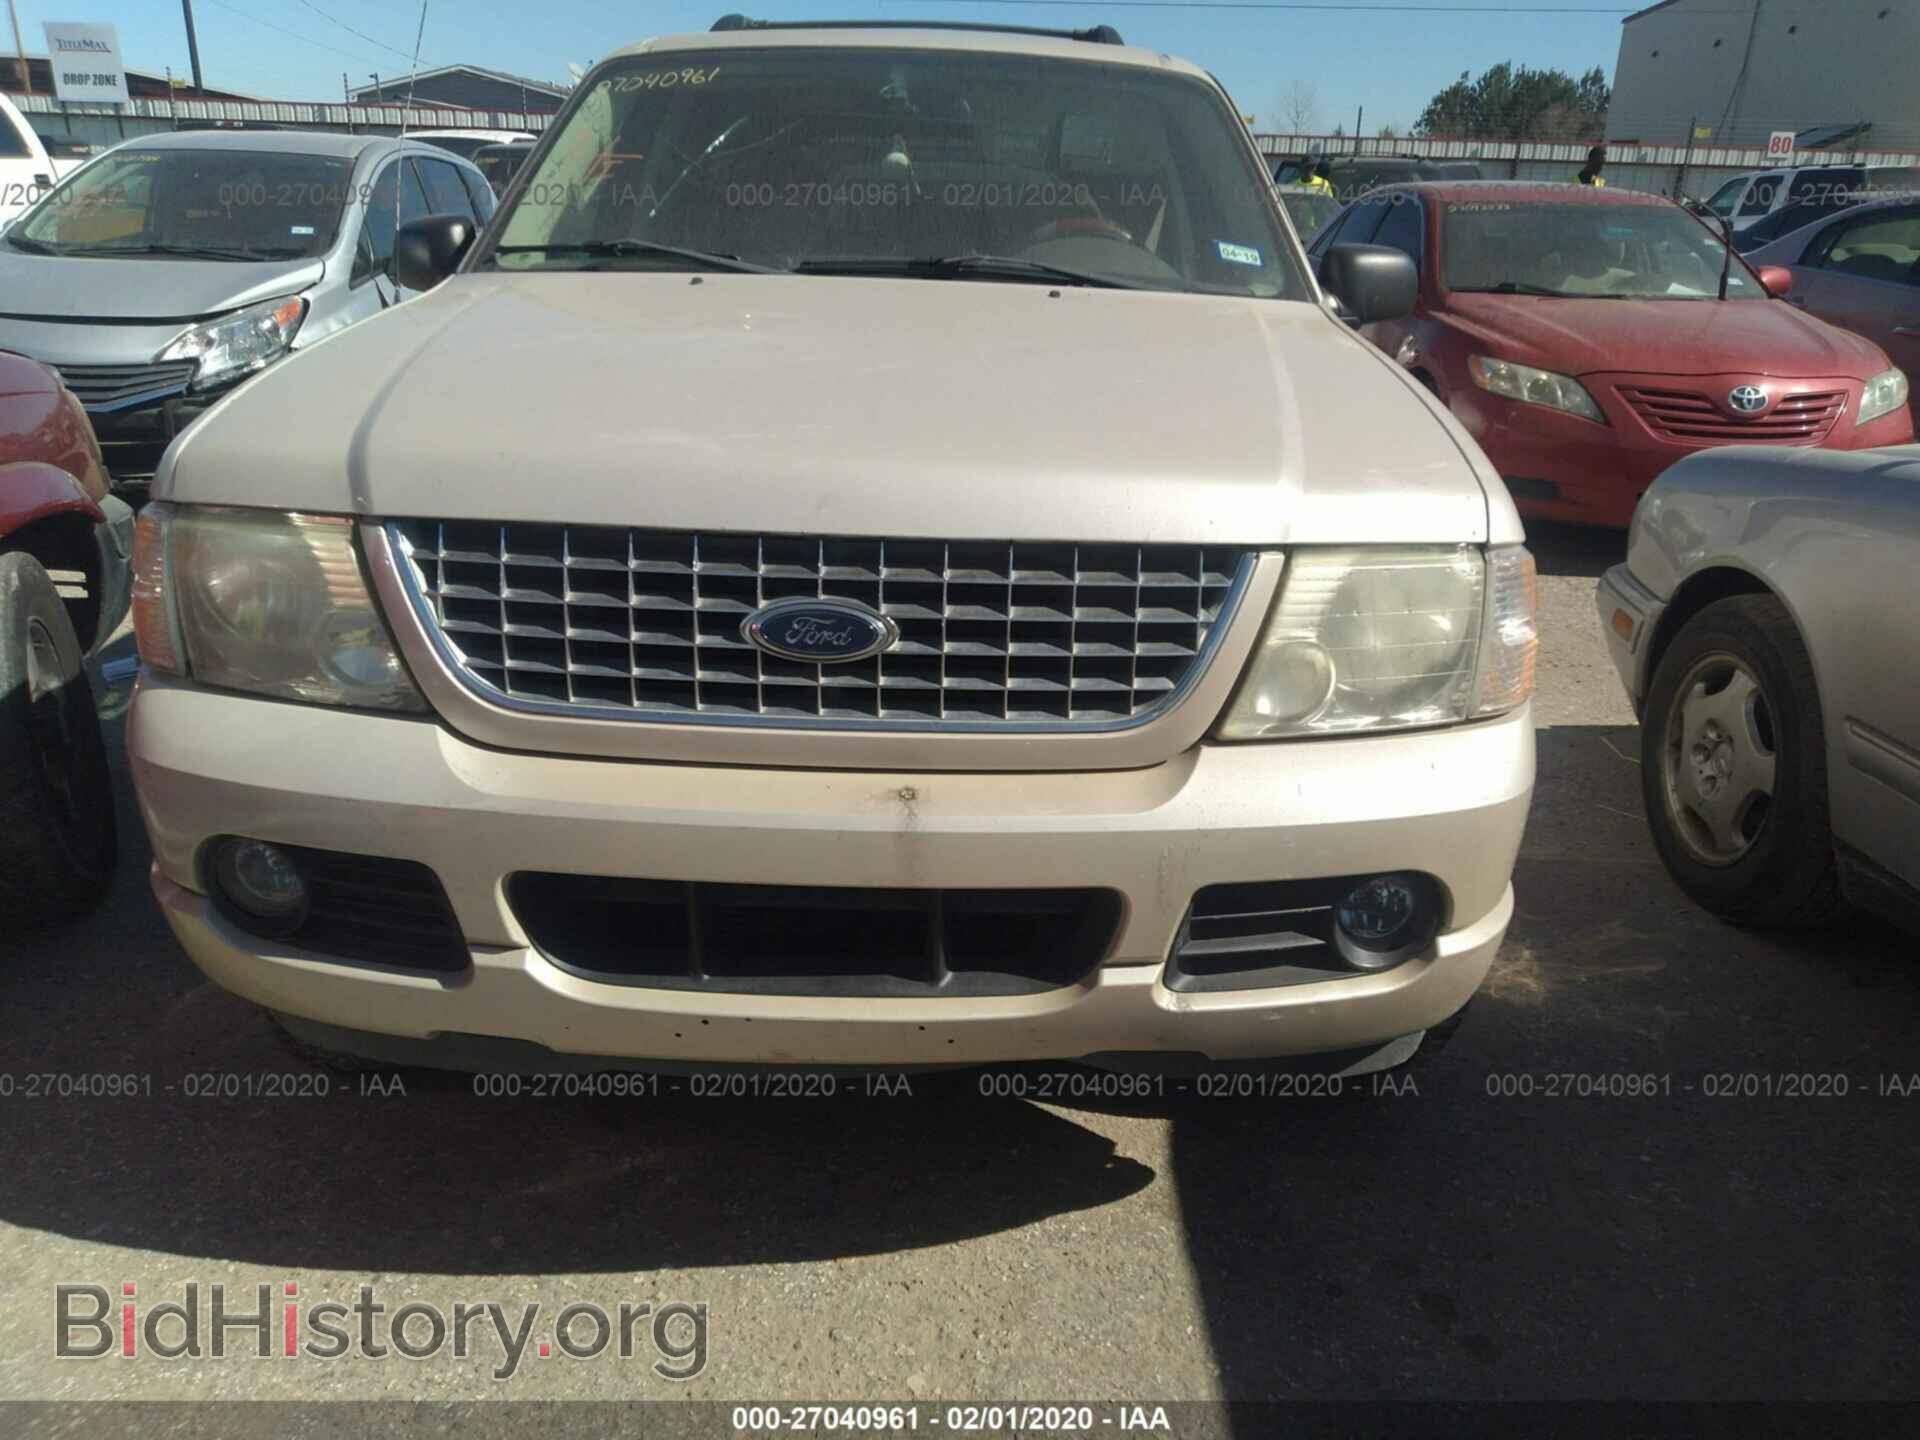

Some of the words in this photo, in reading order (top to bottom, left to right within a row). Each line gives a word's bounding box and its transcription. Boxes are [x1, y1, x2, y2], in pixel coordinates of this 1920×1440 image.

[63, 73, 91, 86] DROP
[92, 73, 118, 87] ZONE
[1771, 136, 1792, 154] 80
[785, 616, 852, 646] Ford
